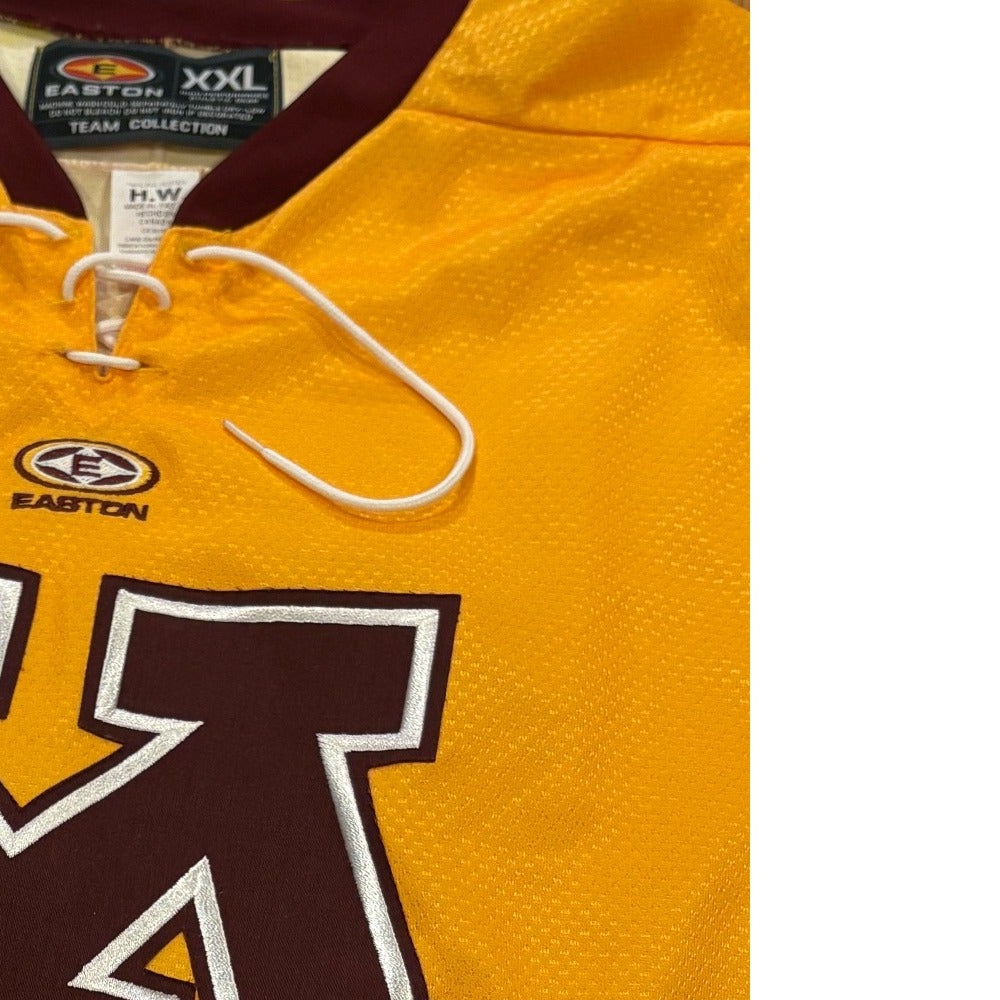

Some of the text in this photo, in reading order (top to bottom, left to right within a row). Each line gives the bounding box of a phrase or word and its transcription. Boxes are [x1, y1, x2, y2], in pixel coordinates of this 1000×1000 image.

[93, 63, 116, 75] E
[181, 64, 269, 91] XXL
[44, 84, 164, 98] EASTON
[69, 119, 229, 136] TEAM COLLECTION
[71, 454, 102, 478] E
[10, 493, 149, 521] EASTON
